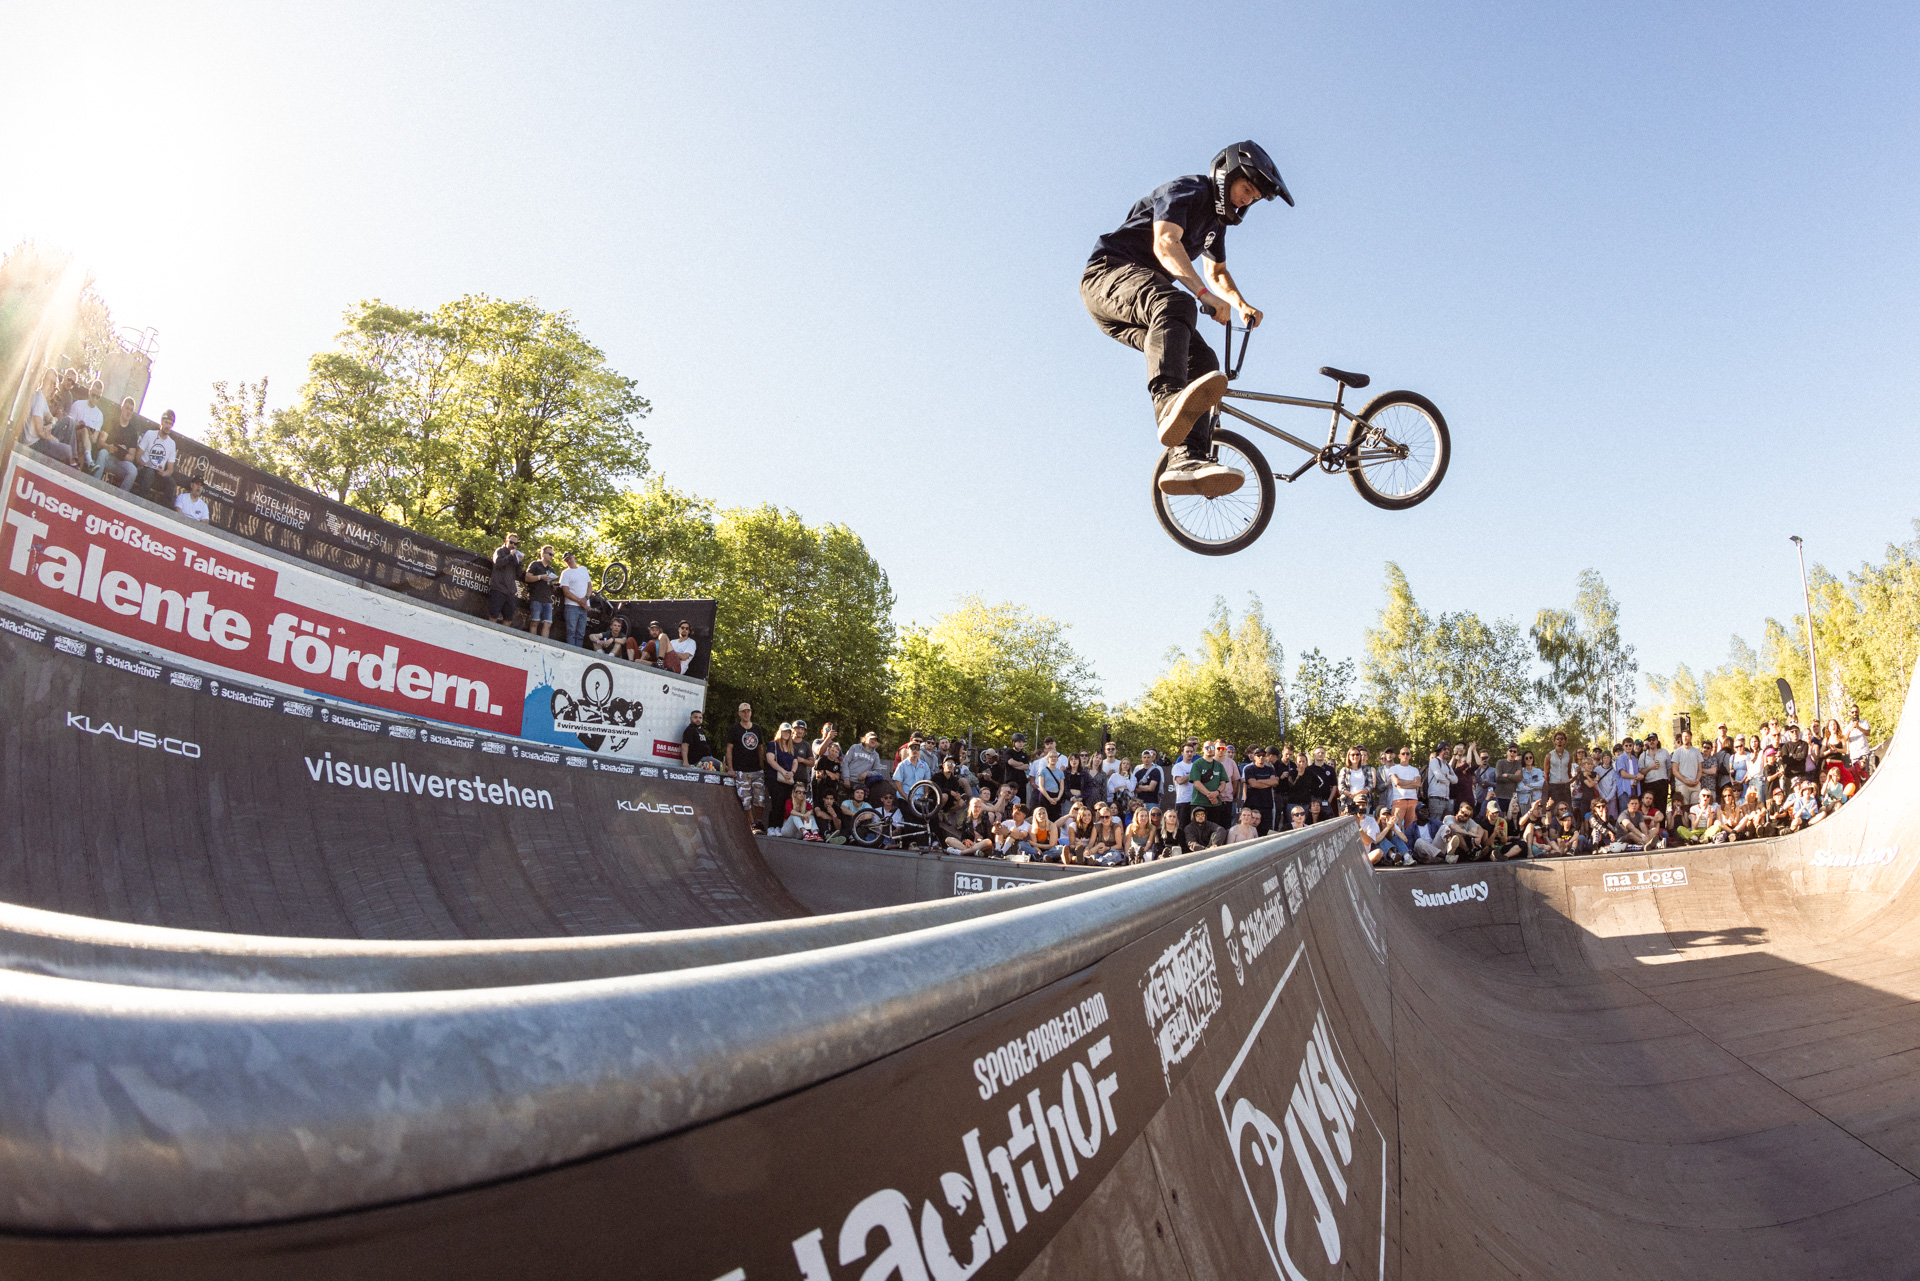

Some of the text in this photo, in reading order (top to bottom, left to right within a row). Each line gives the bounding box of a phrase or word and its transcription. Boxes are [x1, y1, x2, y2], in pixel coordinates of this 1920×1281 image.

[253, 491, 280, 510] HOTEL
[281, 503, 311, 521] HAFEN
[255, 504, 304, 530] FLENSBURG
[16, 477, 255, 590] Unser größtes Talent
[345, 524, 388, 547] NAH.SH
[451, 564, 473, 579] HOTEL
[452, 575, 491, 595] FLENSBUR
[6, 508, 503, 716] Talente fördern.
[66, 712, 201, 758] KLAUS+CO
[557, 722, 639, 736] #wirwissenwaswirtun
[304, 752, 554, 810] visuellverstehen
[1809, 845, 1900, 867] Sunday
[957, 875, 1031, 892] na Lo
[1606, 874, 1632, 887] na
[1411, 881, 1489, 907] Sunday
[1144, 932, 1212, 1029] KEIN BOCK
[1182, 968, 1222, 1040] NAZIS
[1284, 1007, 1357, 1265] JYSK
